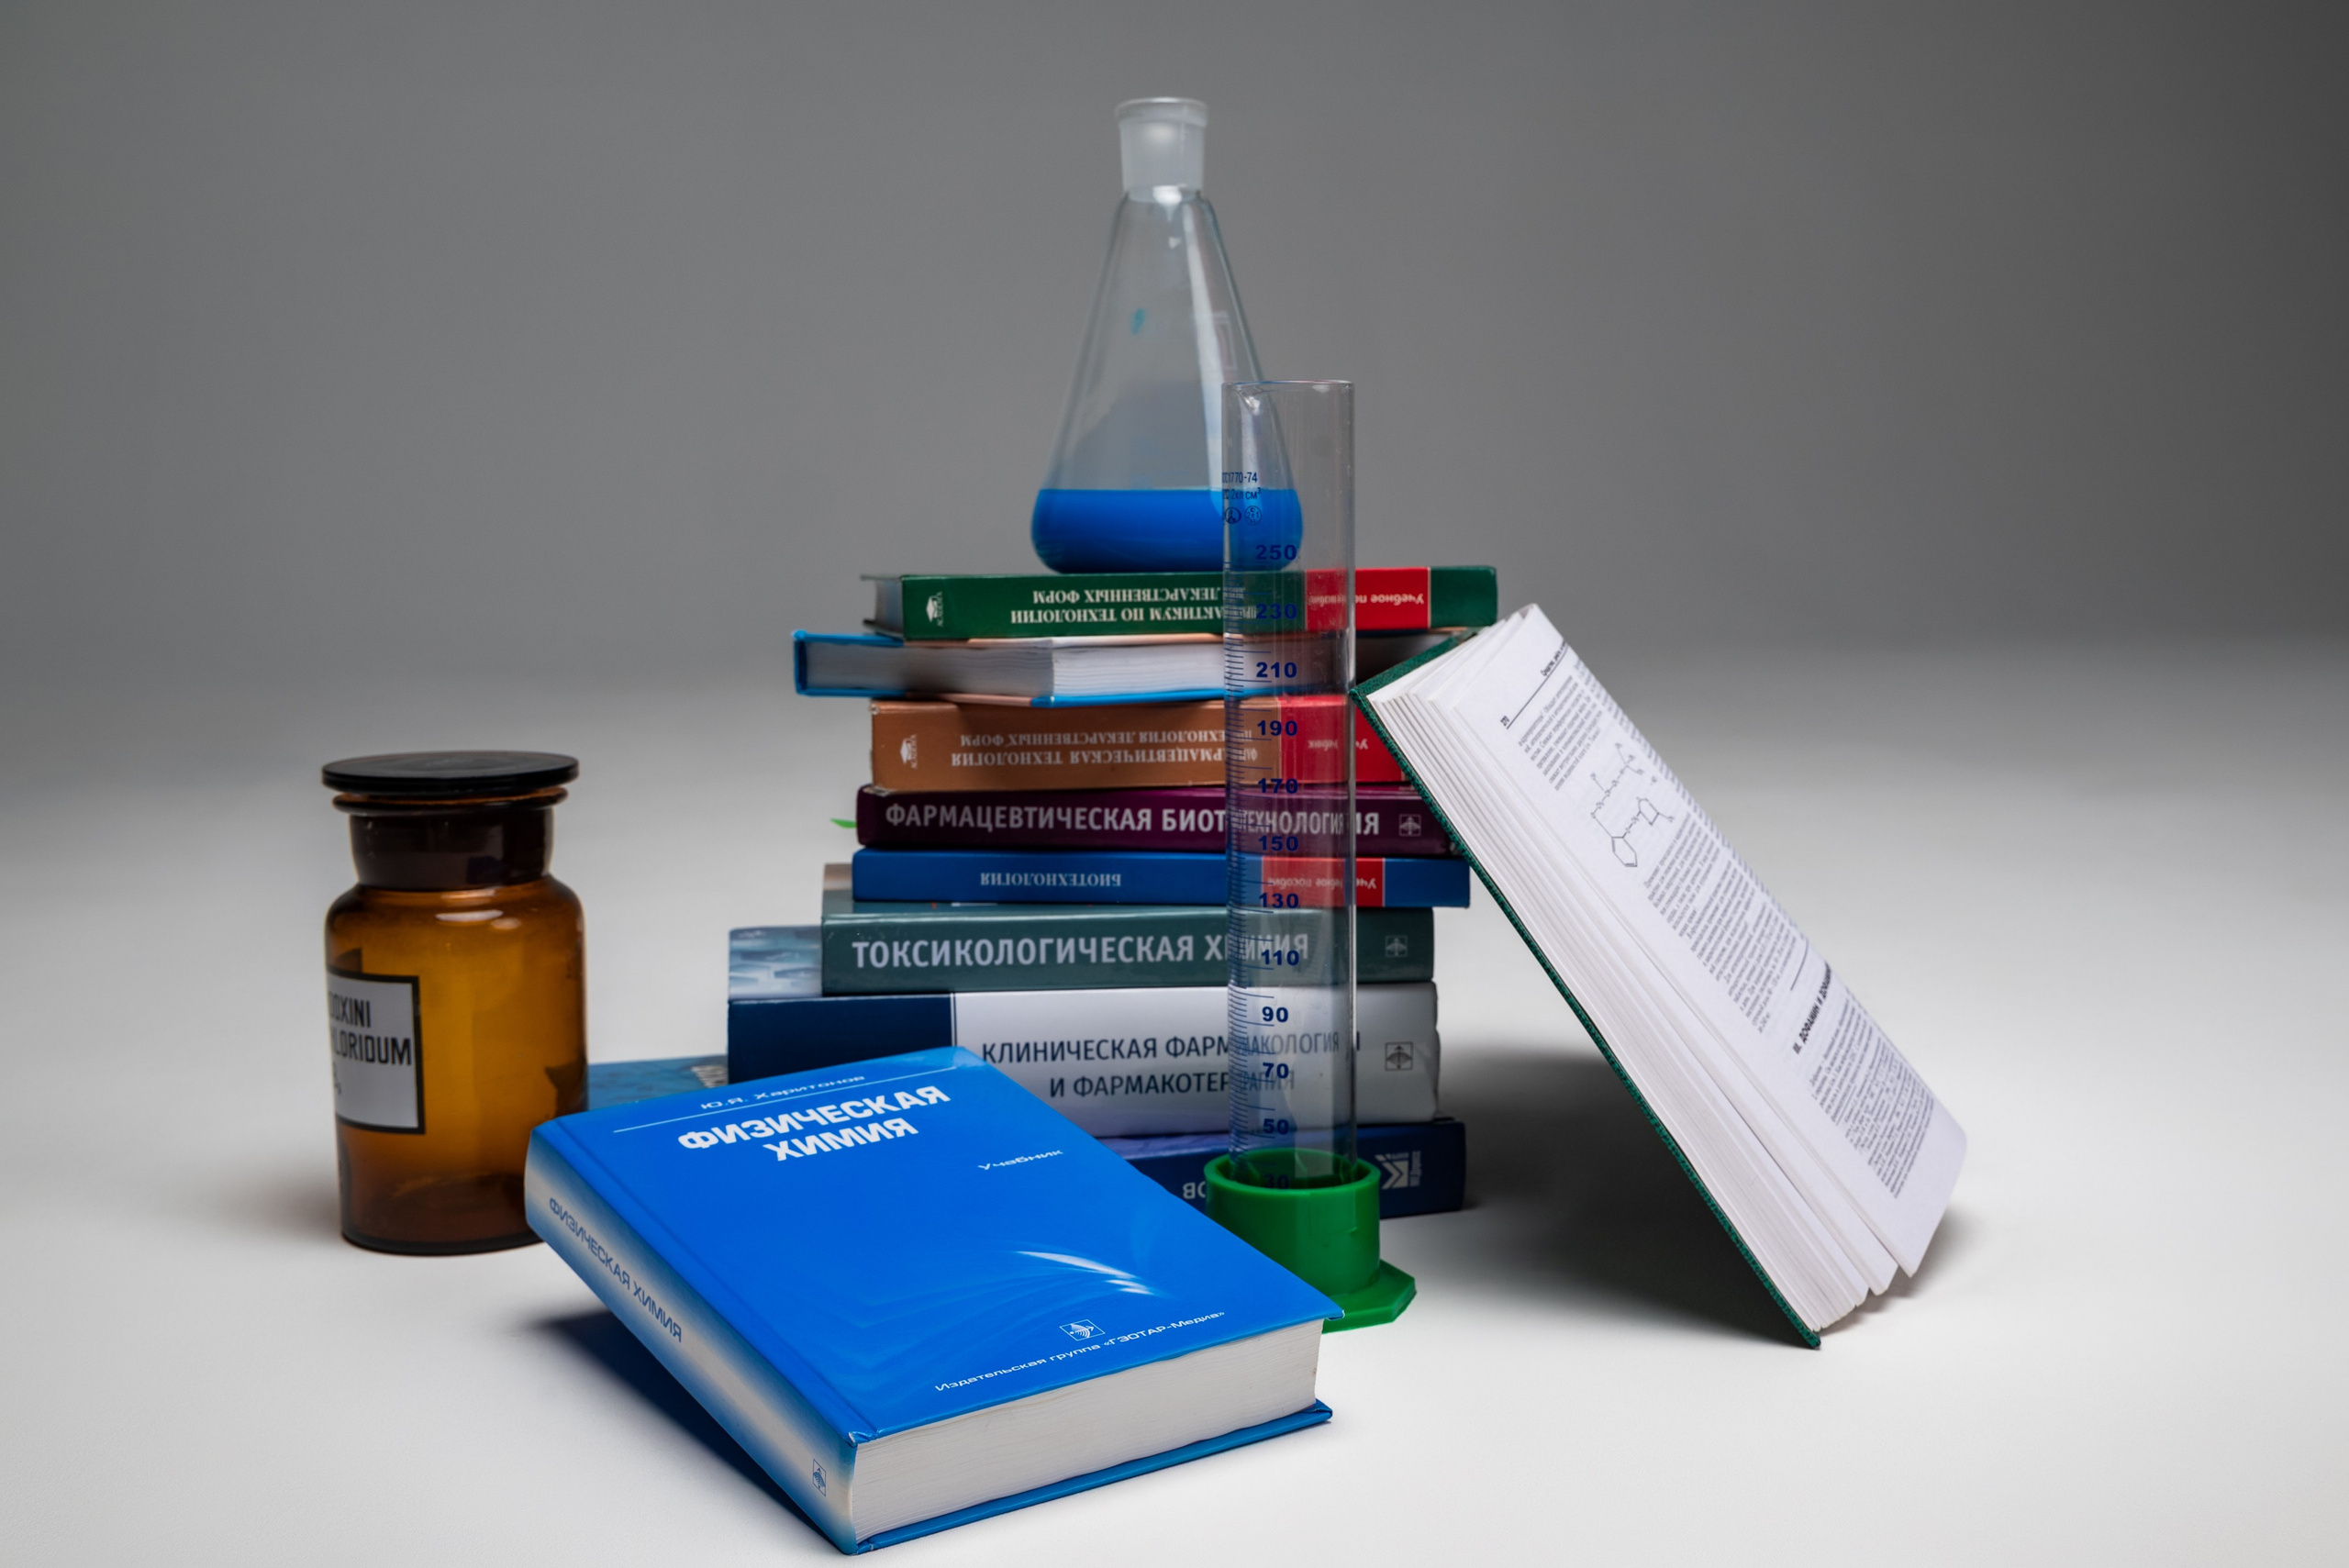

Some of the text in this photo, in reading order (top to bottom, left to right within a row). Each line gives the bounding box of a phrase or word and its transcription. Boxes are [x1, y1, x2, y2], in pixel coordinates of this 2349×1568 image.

[1255, 545, 1297, 561] 250
[1032, 587, 1221, 605] ЛЕКАРСТВЕННЫХ ФОРМ
[1370, 593, 1424, 606] Учебное
[1010, 608, 1118, 625] ТЕХНОЛОГИИ
[1120, 606, 1145, 622] ПО
[1255, 603, 1297, 619] 230
[1255, 662, 1297, 678] 210
[1257, 720, 1298, 737] 190
[959, 733, 1006, 748] ФОРМ
[1008, 731, 1136, 747] ЛЕКАРСТВЕННЫХ
[951, 751, 1064, 767] ТЕХНОЛОГИЯ
[1257, 778, 1298, 795] 170
[885, 803, 1152, 832] ФАРМАЦЕВТИЧЕСКАЯ
[1258, 835, 1299, 851] 150
[980, 872, 1122, 887] БИОТЕХНОЛОГИЯ
[1259, 893, 1299, 909] 130
[852, 934, 1194, 969] ТОКСИКОЛОГИЧЕСКАЯ
[1261, 949, 1300, 966] 110
[1262, 1006, 1289, 1023] 90
[983, 1037, 1158, 1064] КЛИНИЧЕСКАЯ
[1263, 1062, 1289, 1079] 70
[754, 1075, 865, 1100] Харитонов
[1050, 1077, 1065, 1098] И
[678, 1085, 951, 1149] ФИЗИЧЕСКАЯ
[1263, 1118, 1290, 1135] 50
[763, 1118, 918, 1162] ХИМИЯ
[977, 1150, 1063, 1171] Учебник
[549, 1196, 682, 1343] ФИЗИЧЕСКАЯ ХИМИЯ
[934, 1311, 1226, 1392] Издательская группа «ГЭОТАР-Медиа»
